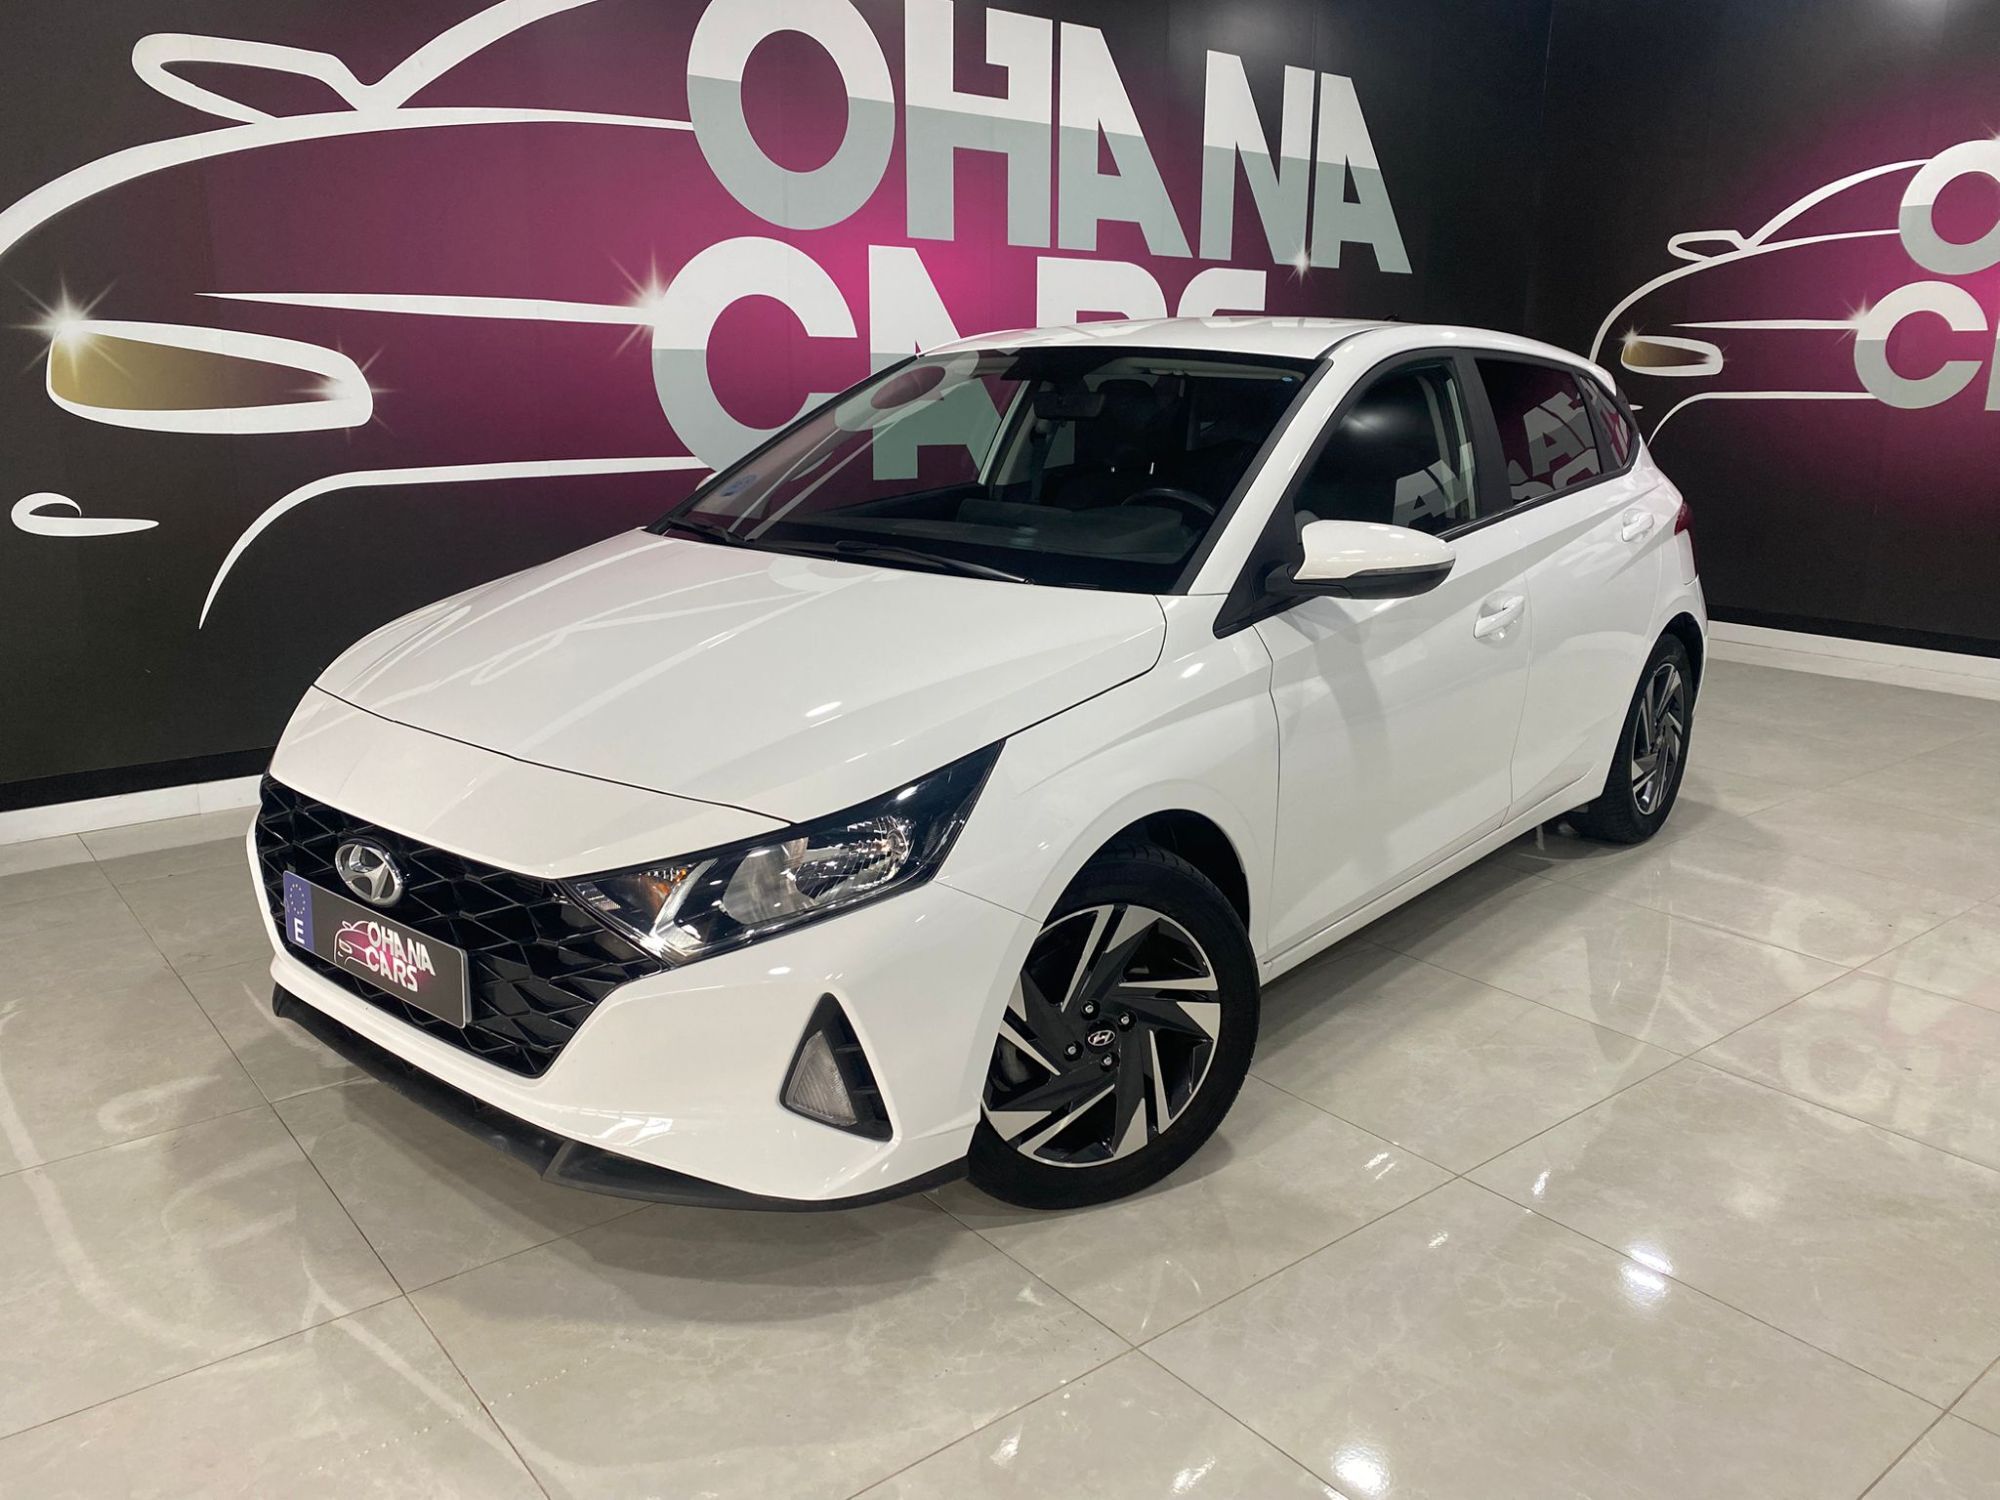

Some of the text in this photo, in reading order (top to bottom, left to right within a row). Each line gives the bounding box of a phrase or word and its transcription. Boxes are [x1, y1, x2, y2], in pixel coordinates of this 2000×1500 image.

[687, 0, 1412, 274] OHANA
[652, 236, 1267, 480] CA
[294, 917, 305, 944] E
[367, 921, 436, 976] OHANA
[365, 946, 418, 992] CARS
